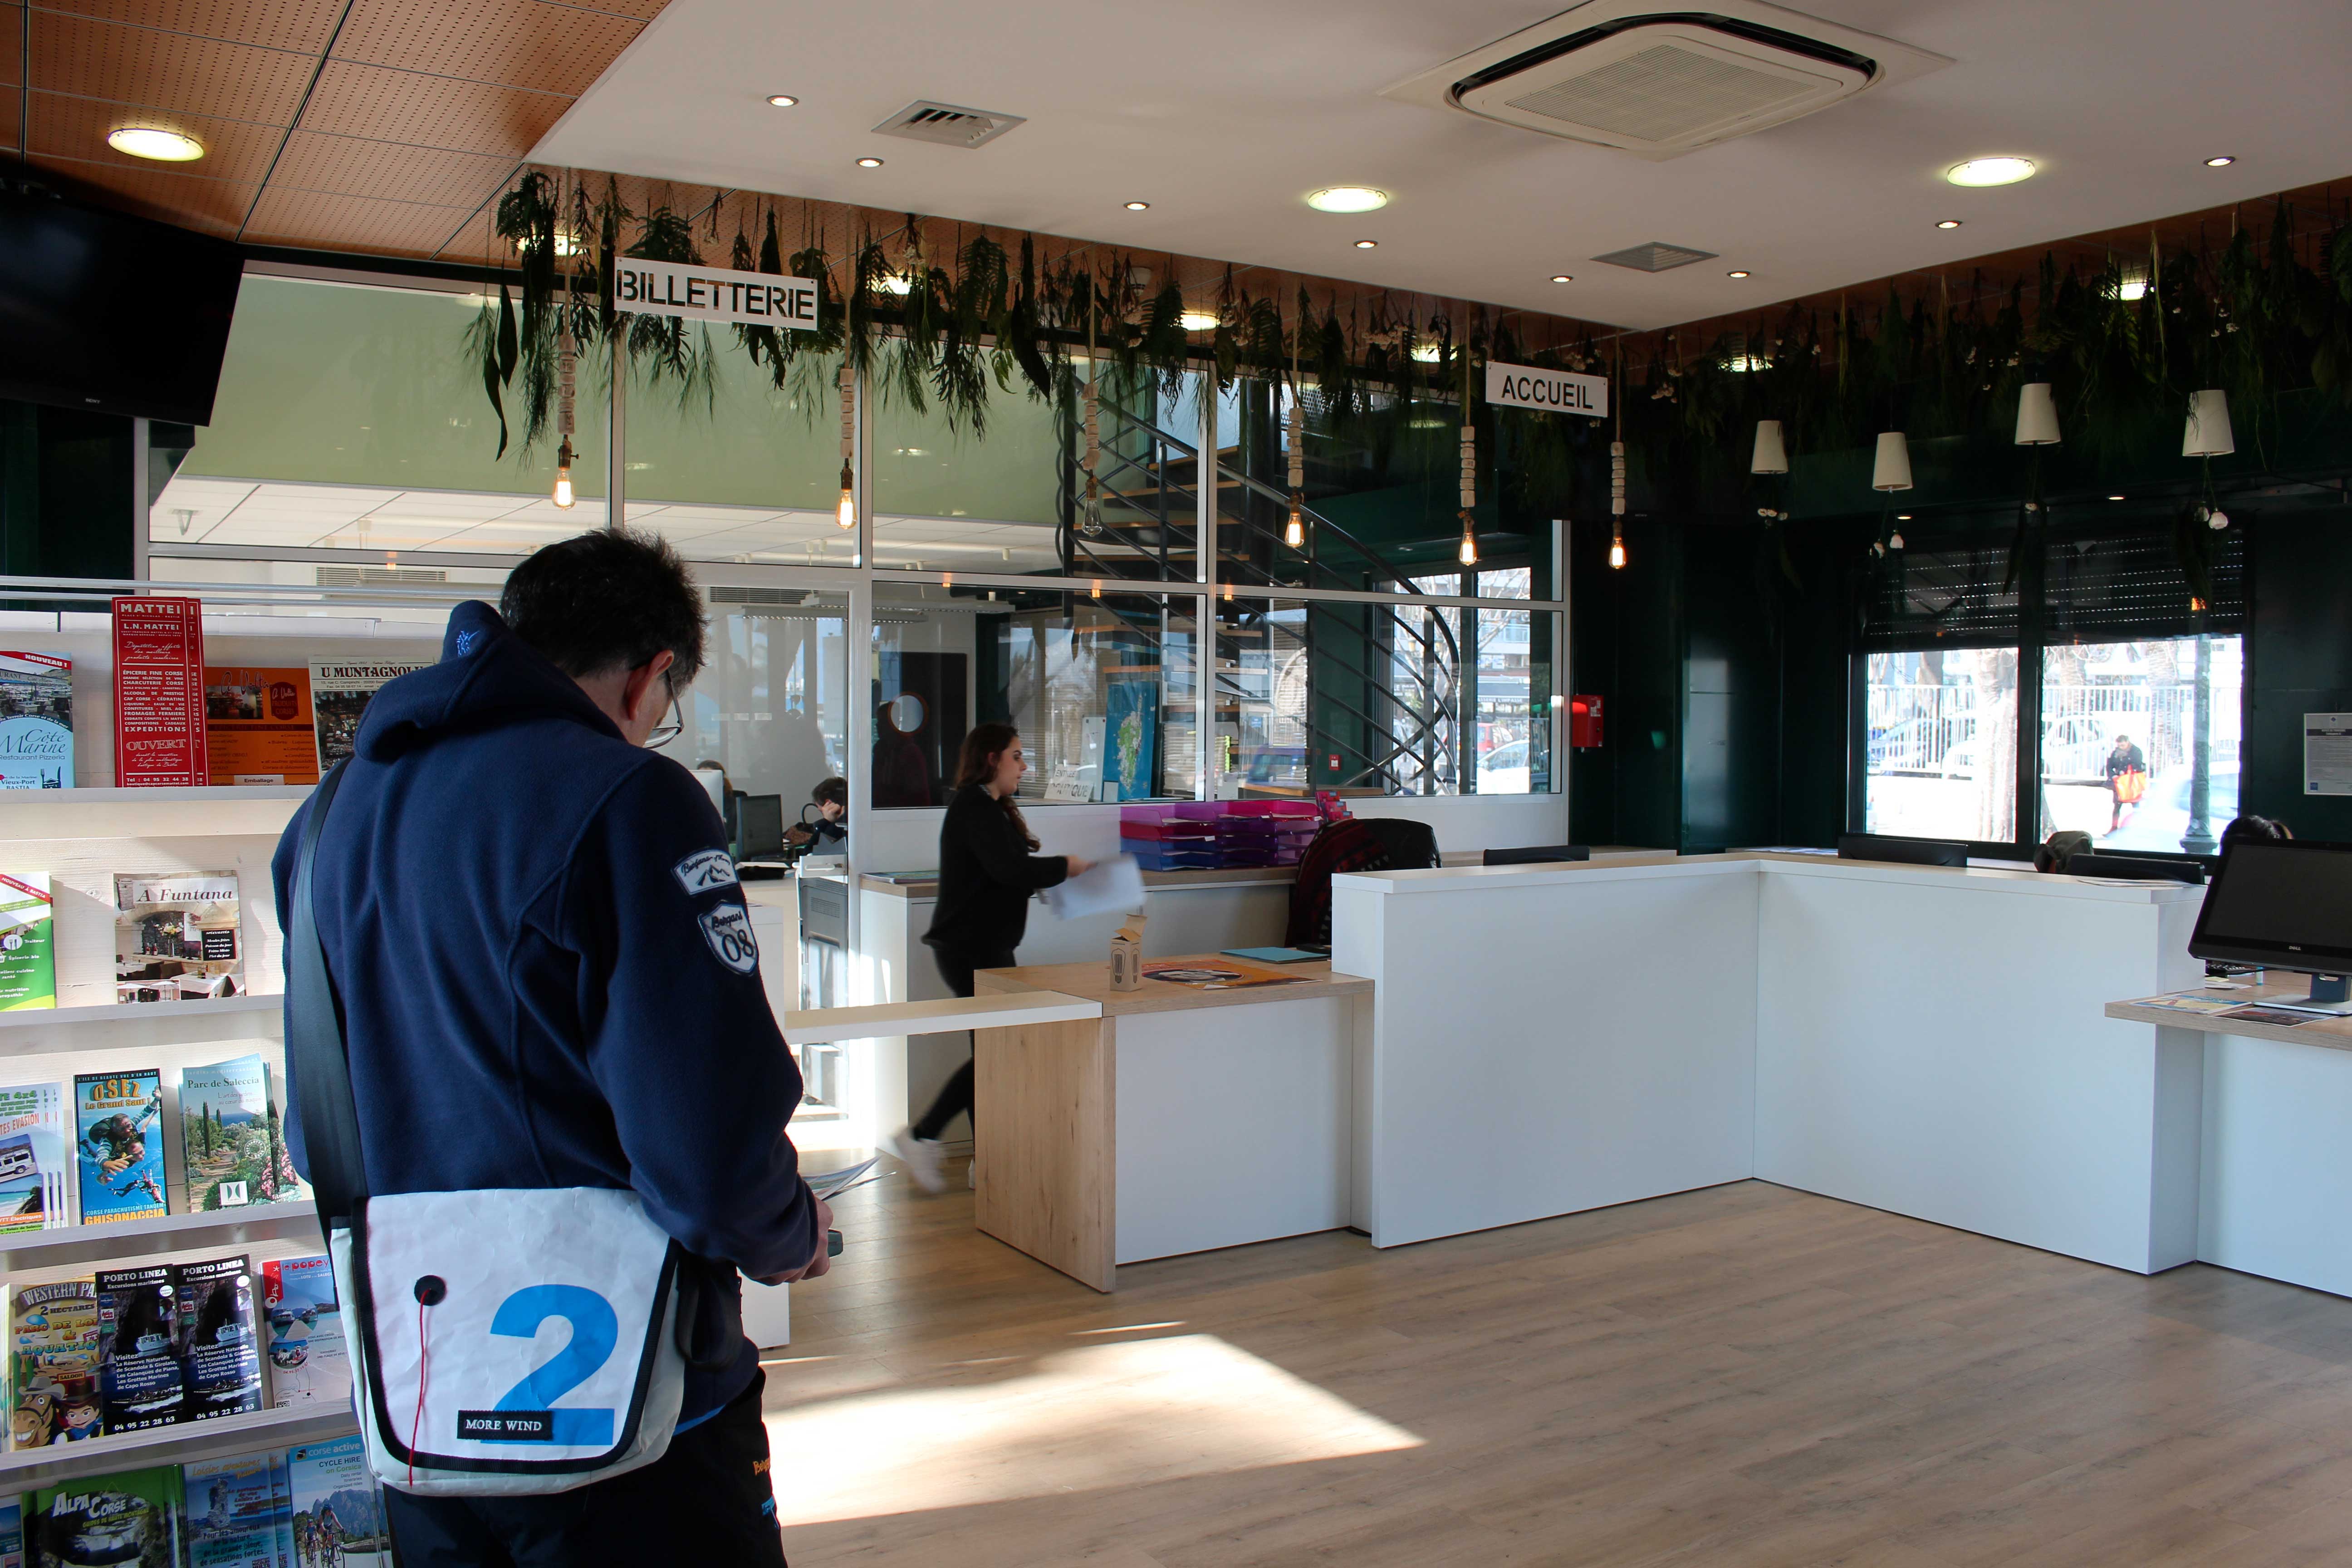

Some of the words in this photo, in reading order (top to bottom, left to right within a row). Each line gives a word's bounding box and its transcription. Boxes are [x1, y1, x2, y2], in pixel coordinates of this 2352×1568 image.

[616, 269, 814, 320] BILLETTERIE
[1501, 375, 1593, 409] ACCUEIL
[121, 604, 181, 614] MATTEI
[25, 654, 62, 666] NOUVEAU
[321, 667, 330, 677] U
[334, 666, 422, 677] MUNTAGNO
[25, 729, 67, 742] Côté
[0, 735, 68, 754] Marine
[126, 739, 186, 751] OUVERT
[2, 877, 24, 889] NOUVEAU
[29, 889, 45, 898] BASTIA
[137, 889, 152, 902] A
[159, 888, 233, 901] Funtana
[722, 929, 754, 963] 08
[187, 1080, 208, 1088] Parc
[223, 1077, 260, 1087] Saleccia
[14, 1090, 37, 1099] 4x4
[93, 1078, 141, 1101] OSEZ
[97, 1100, 124, 1108] Grand
[126, 1098, 147, 1106] Saut
[0, 1122, 10, 1136] TES
[12, 1112, 39, 1131] EVASION
[104, 1205, 143, 1214] PARACHUTISME
[84, 1208, 166, 1225] GHISONACCIA
[182, 1265, 215, 1275] PORTO
[216, 1259, 245, 1271] LINEA
[216, 1269, 242, 1278] maritimes
[103, 1272, 137, 1282] PORTO
[138, 1269, 168, 1279] LINEA
[22, 1282, 78, 1306] WESTERN
[80, 1283, 96, 1298] PA
[40, 1306, 48, 1315] 2
[49, 1303, 95, 1314] HECTARES
[15, 1324, 49, 1334] PARC
[52, 1321, 71, 1330] DE
[62, 1330, 77, 1341] &
[21, 1340, 97, 1356] AQUATIQ
[226, 1344, 249, 1352] Naturelle
[490, 1284, 618, 1445] 2
[466, 1419, 501, 1431] MORE
[506, 1421, 542, 1431] WIND
[309, 1447, 331, 1456] corse
[333, 1442, 360, 1452] active
[319, 1459, 343, 1467] CYCLE
[344, 1455, 361, 1464] HIRE
[337, 1464, 362, 1472] Corsica
[52, 1491, 90, 1518] ALPA
[88, 1496, 126, 1518] CORSE
[230, 1524, 260, 1535] amoureux
[209, 1553, 243, 1565] sensations
